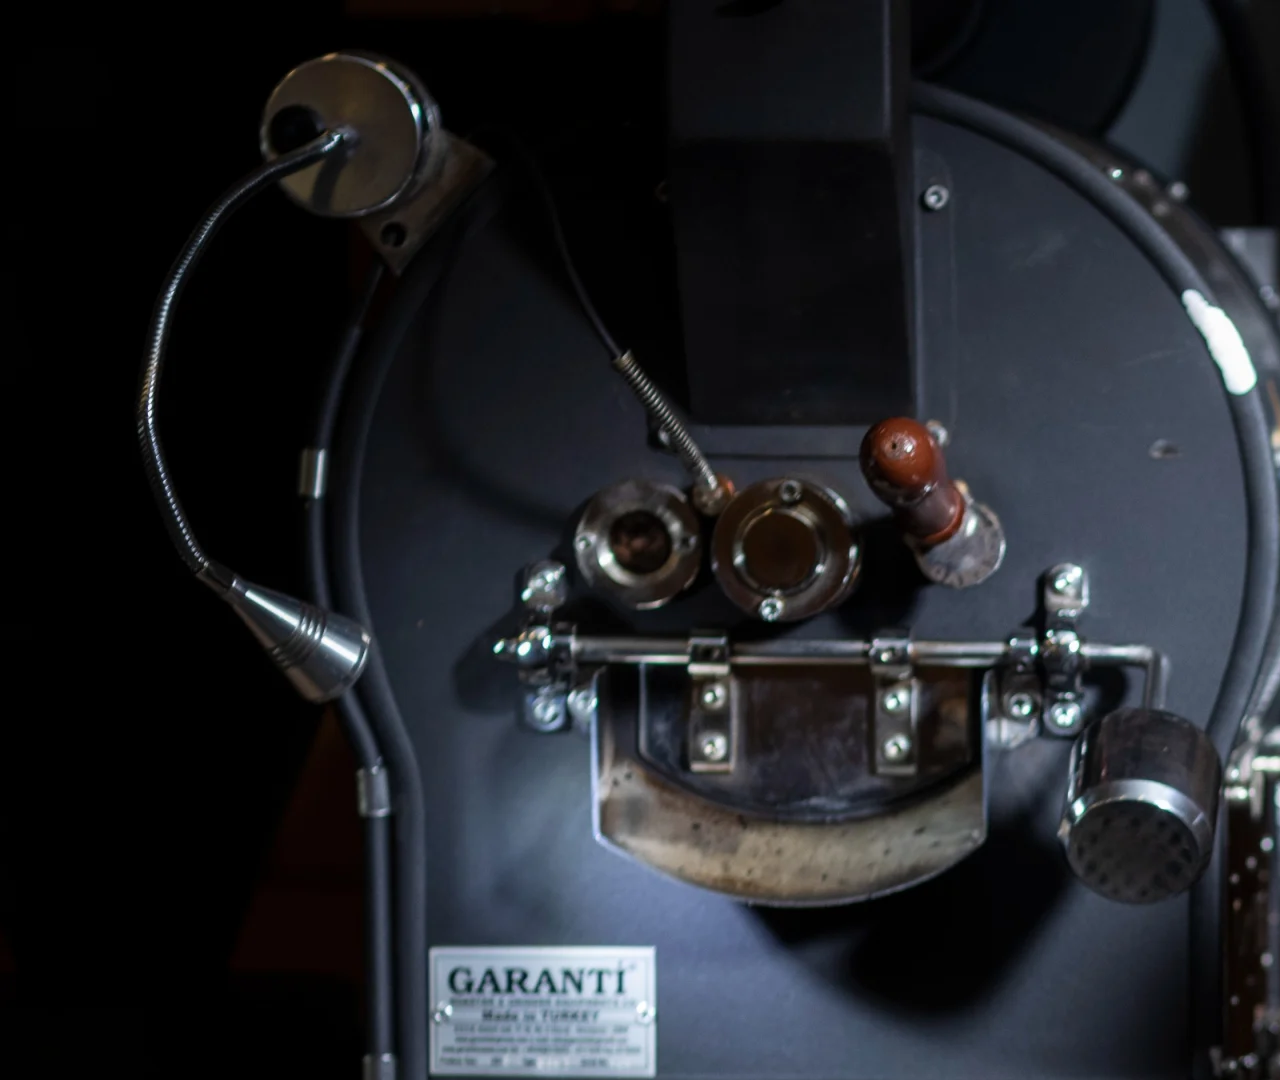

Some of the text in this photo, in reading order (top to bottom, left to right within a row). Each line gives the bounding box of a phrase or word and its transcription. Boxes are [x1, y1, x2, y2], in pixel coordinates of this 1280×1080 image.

[482, 1009, 600, 1022] Made in TURKEY
